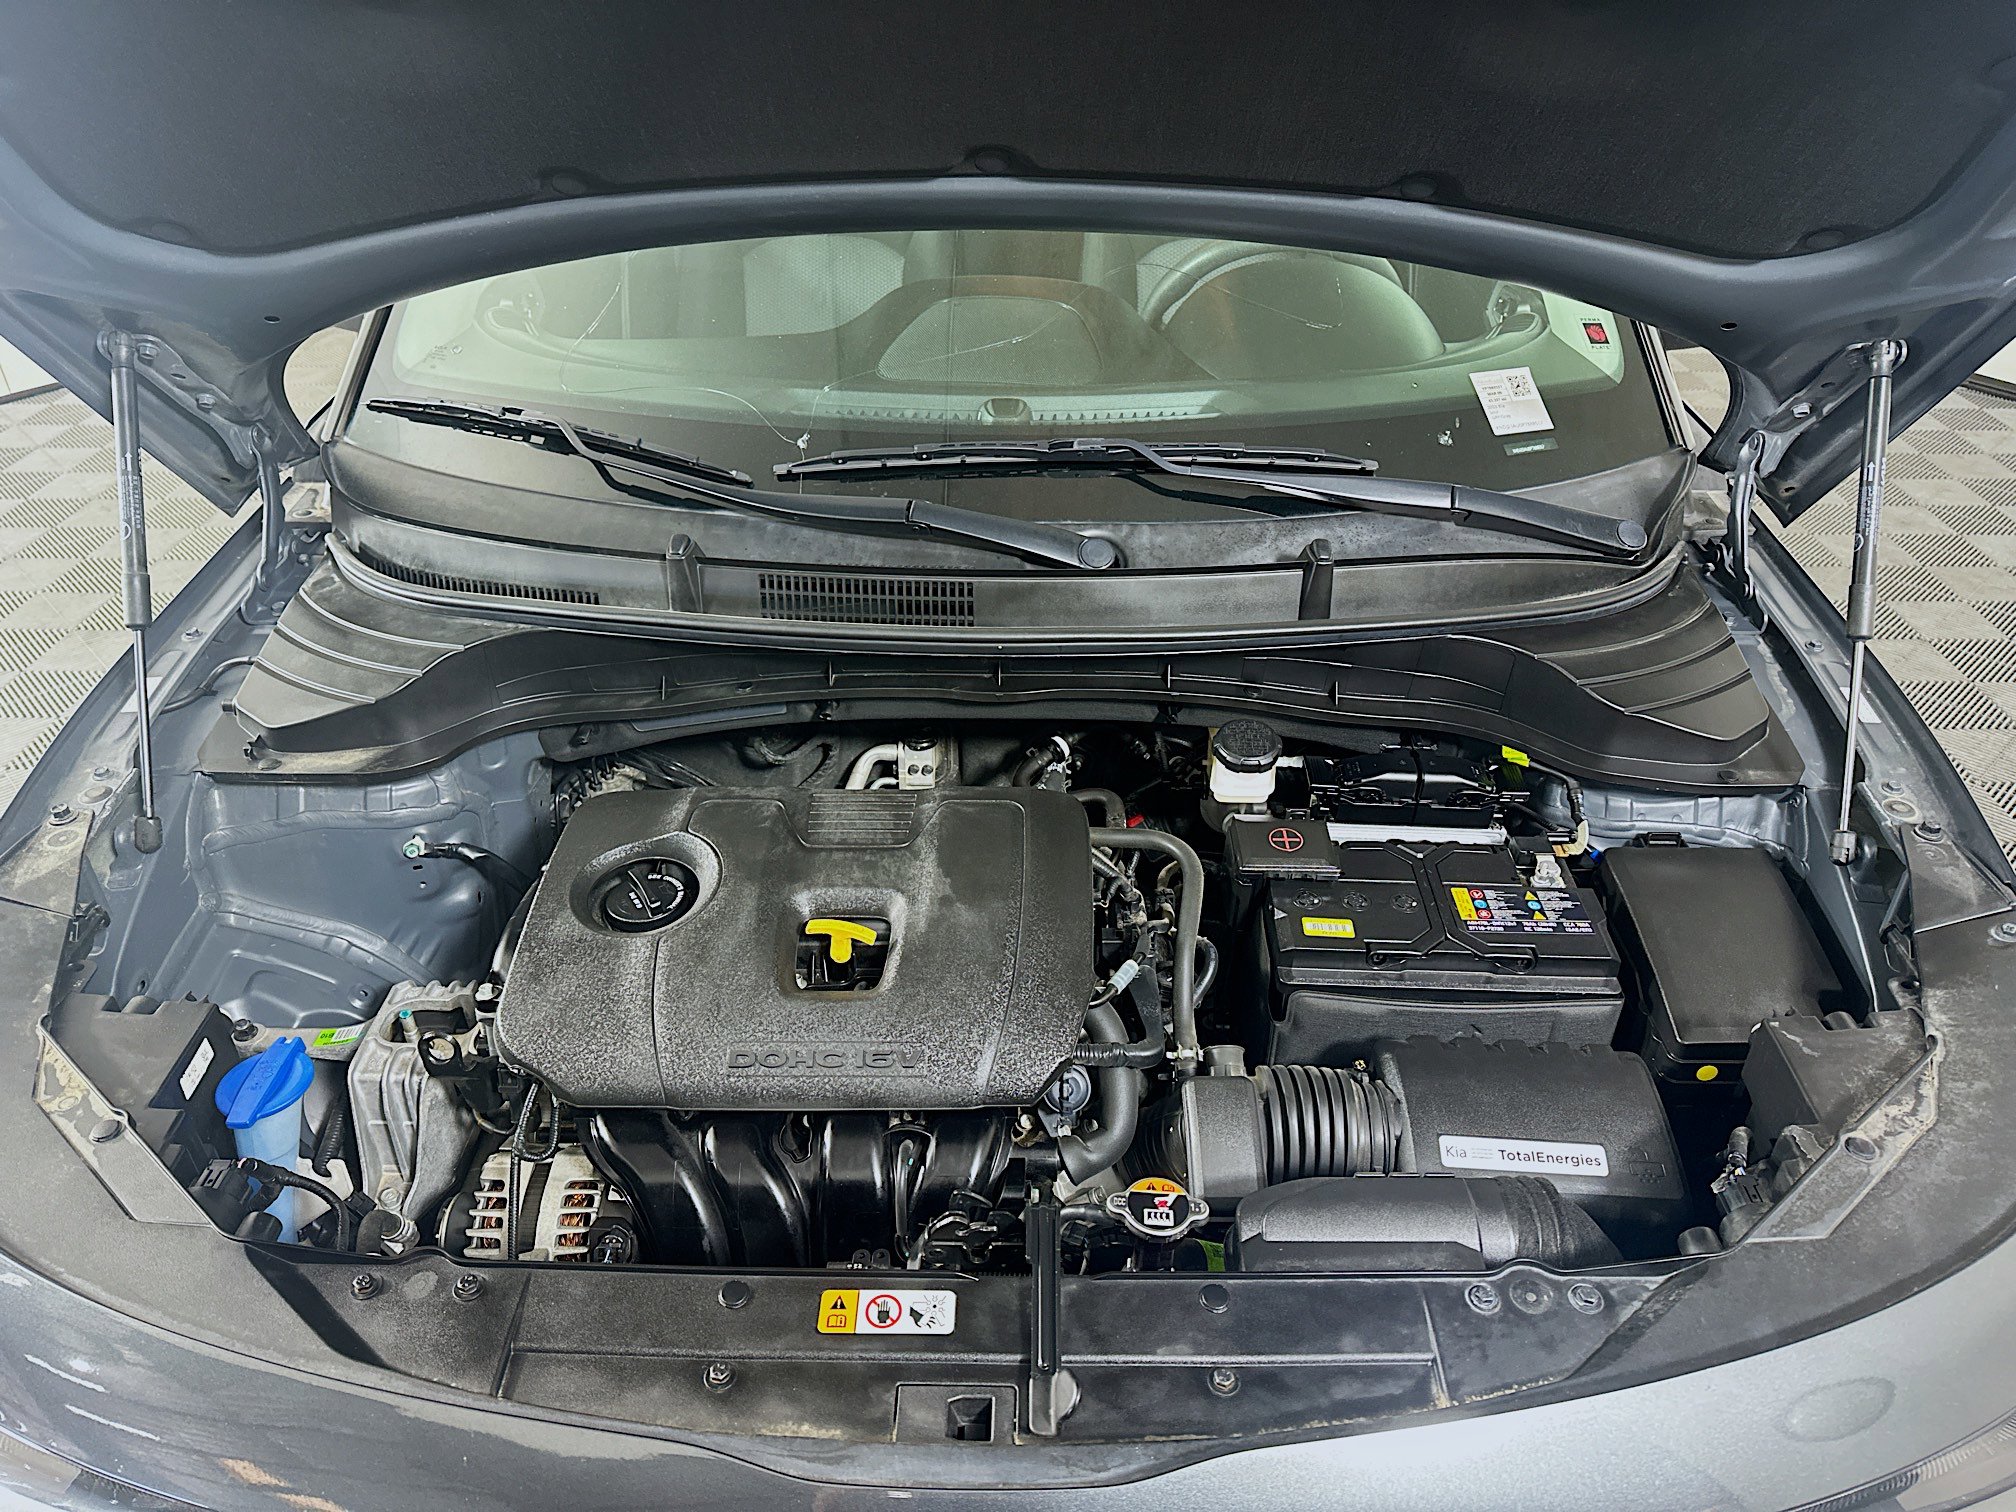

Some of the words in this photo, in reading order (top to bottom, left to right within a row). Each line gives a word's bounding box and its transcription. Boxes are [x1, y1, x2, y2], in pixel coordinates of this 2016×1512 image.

[728, 1050, 846, 1068] DOHC
[855, 1050, 923, 1068] 16V
[1445, 1145, 1467, 1158] Kia
[1498, 1149, 1602, 1167] TotalEnergies
